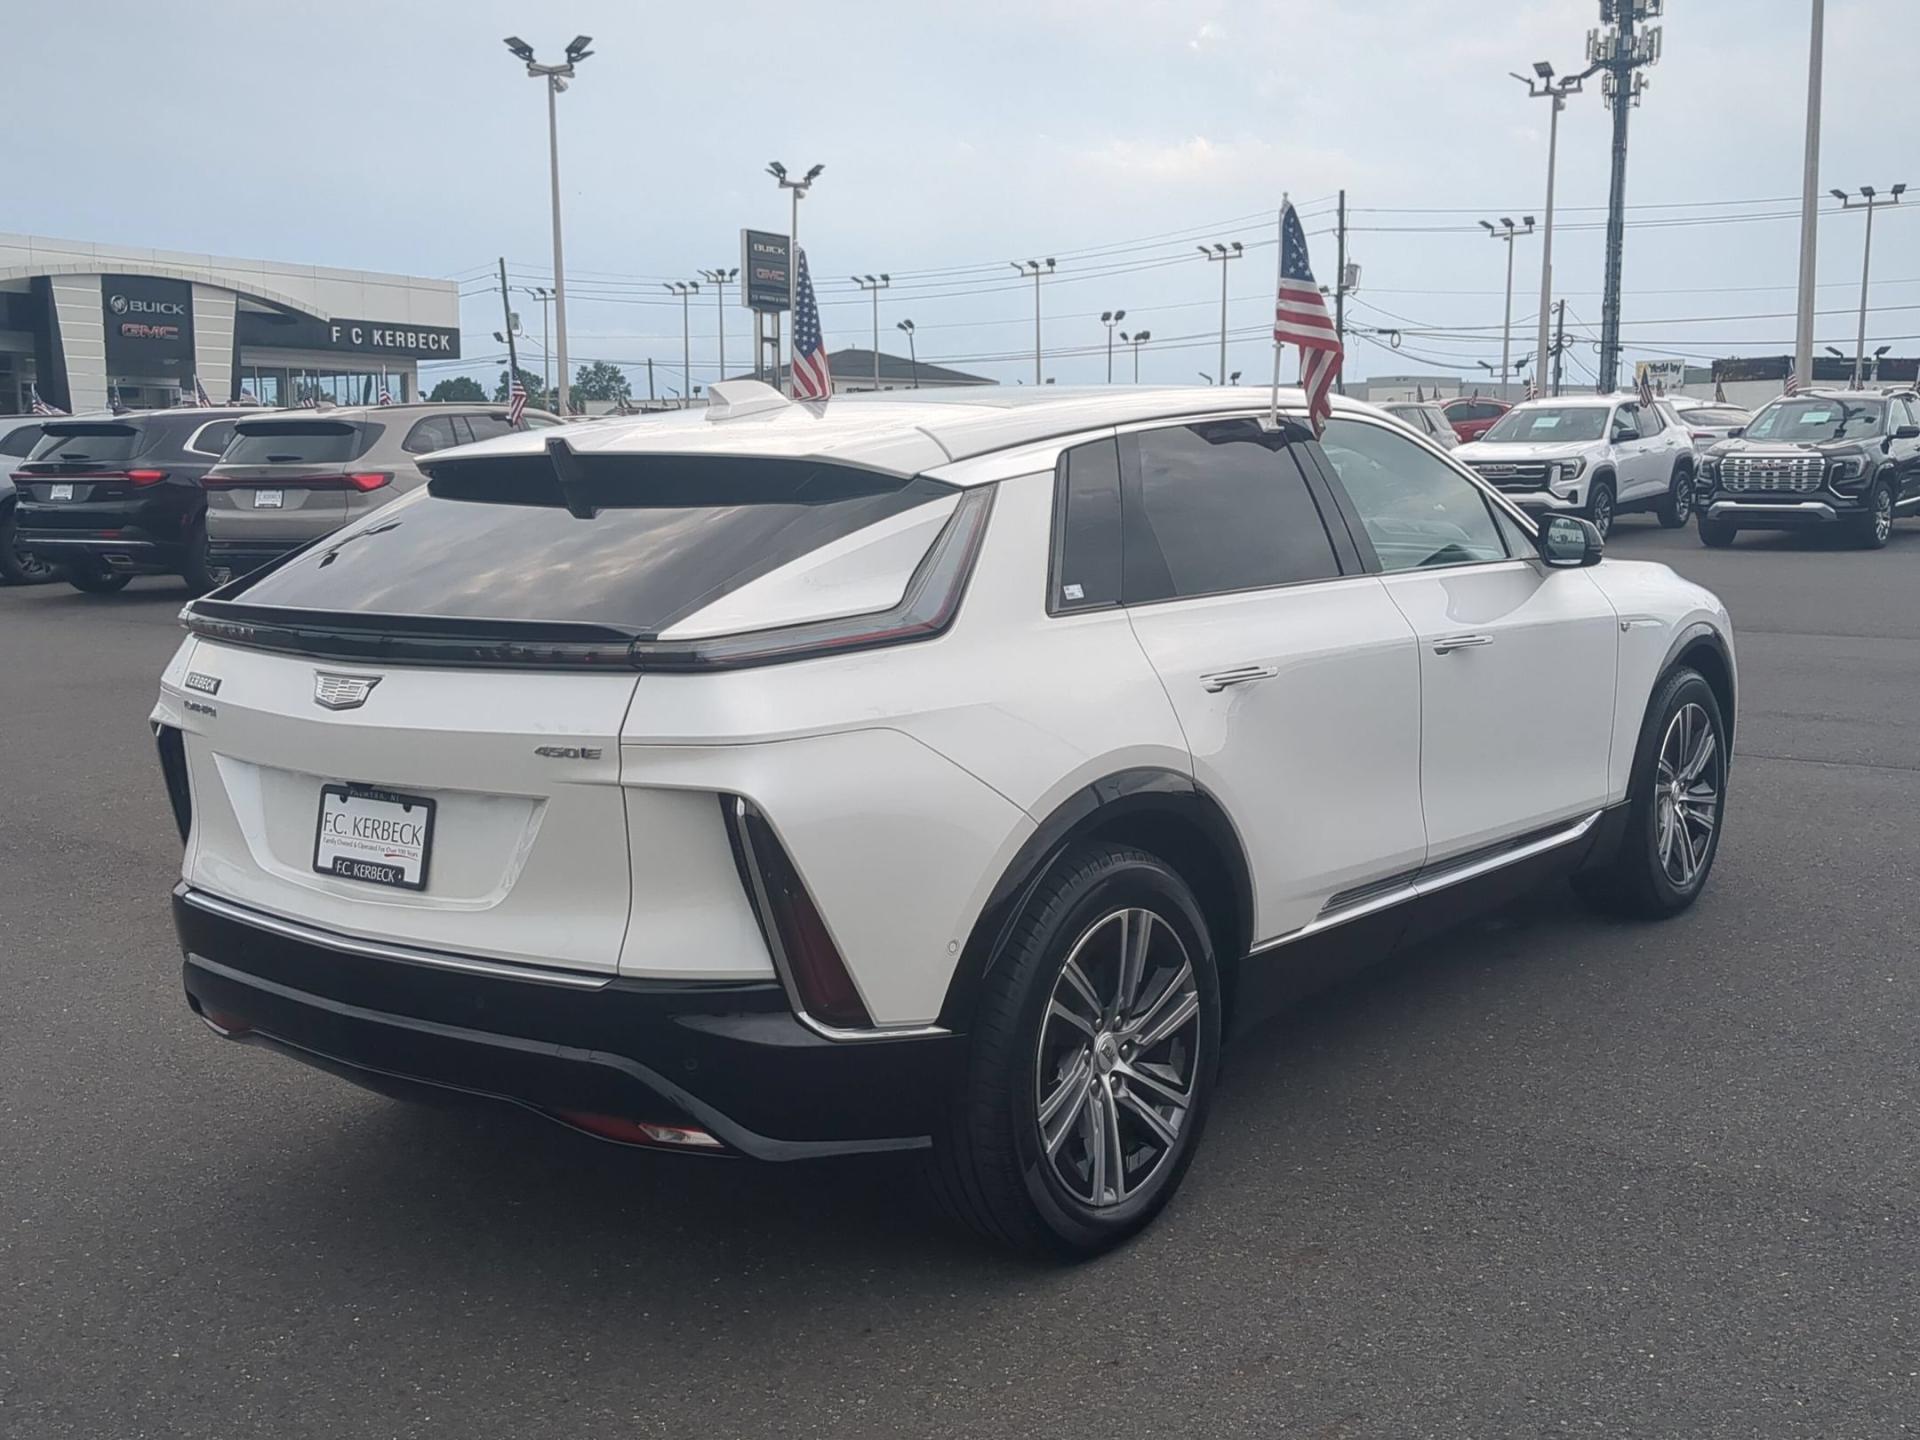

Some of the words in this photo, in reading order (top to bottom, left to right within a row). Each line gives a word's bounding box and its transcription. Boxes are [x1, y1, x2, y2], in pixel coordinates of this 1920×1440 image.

[754, 244, 785, 255] BUICK
[757, 269, 784, 280] GMC
[129, 300, 185, 315] BUICK
[122, 324, 178, 339] GMC
[332, 326, 341, 342] F
[352, 328, 362, 344] C
[373, 329, 450, 350] KERBECK
[323, 812, 347, 835] F.C.
[352, 816, 423, 846] KERBECK
[354, 863, 395, 883] KERBECK
